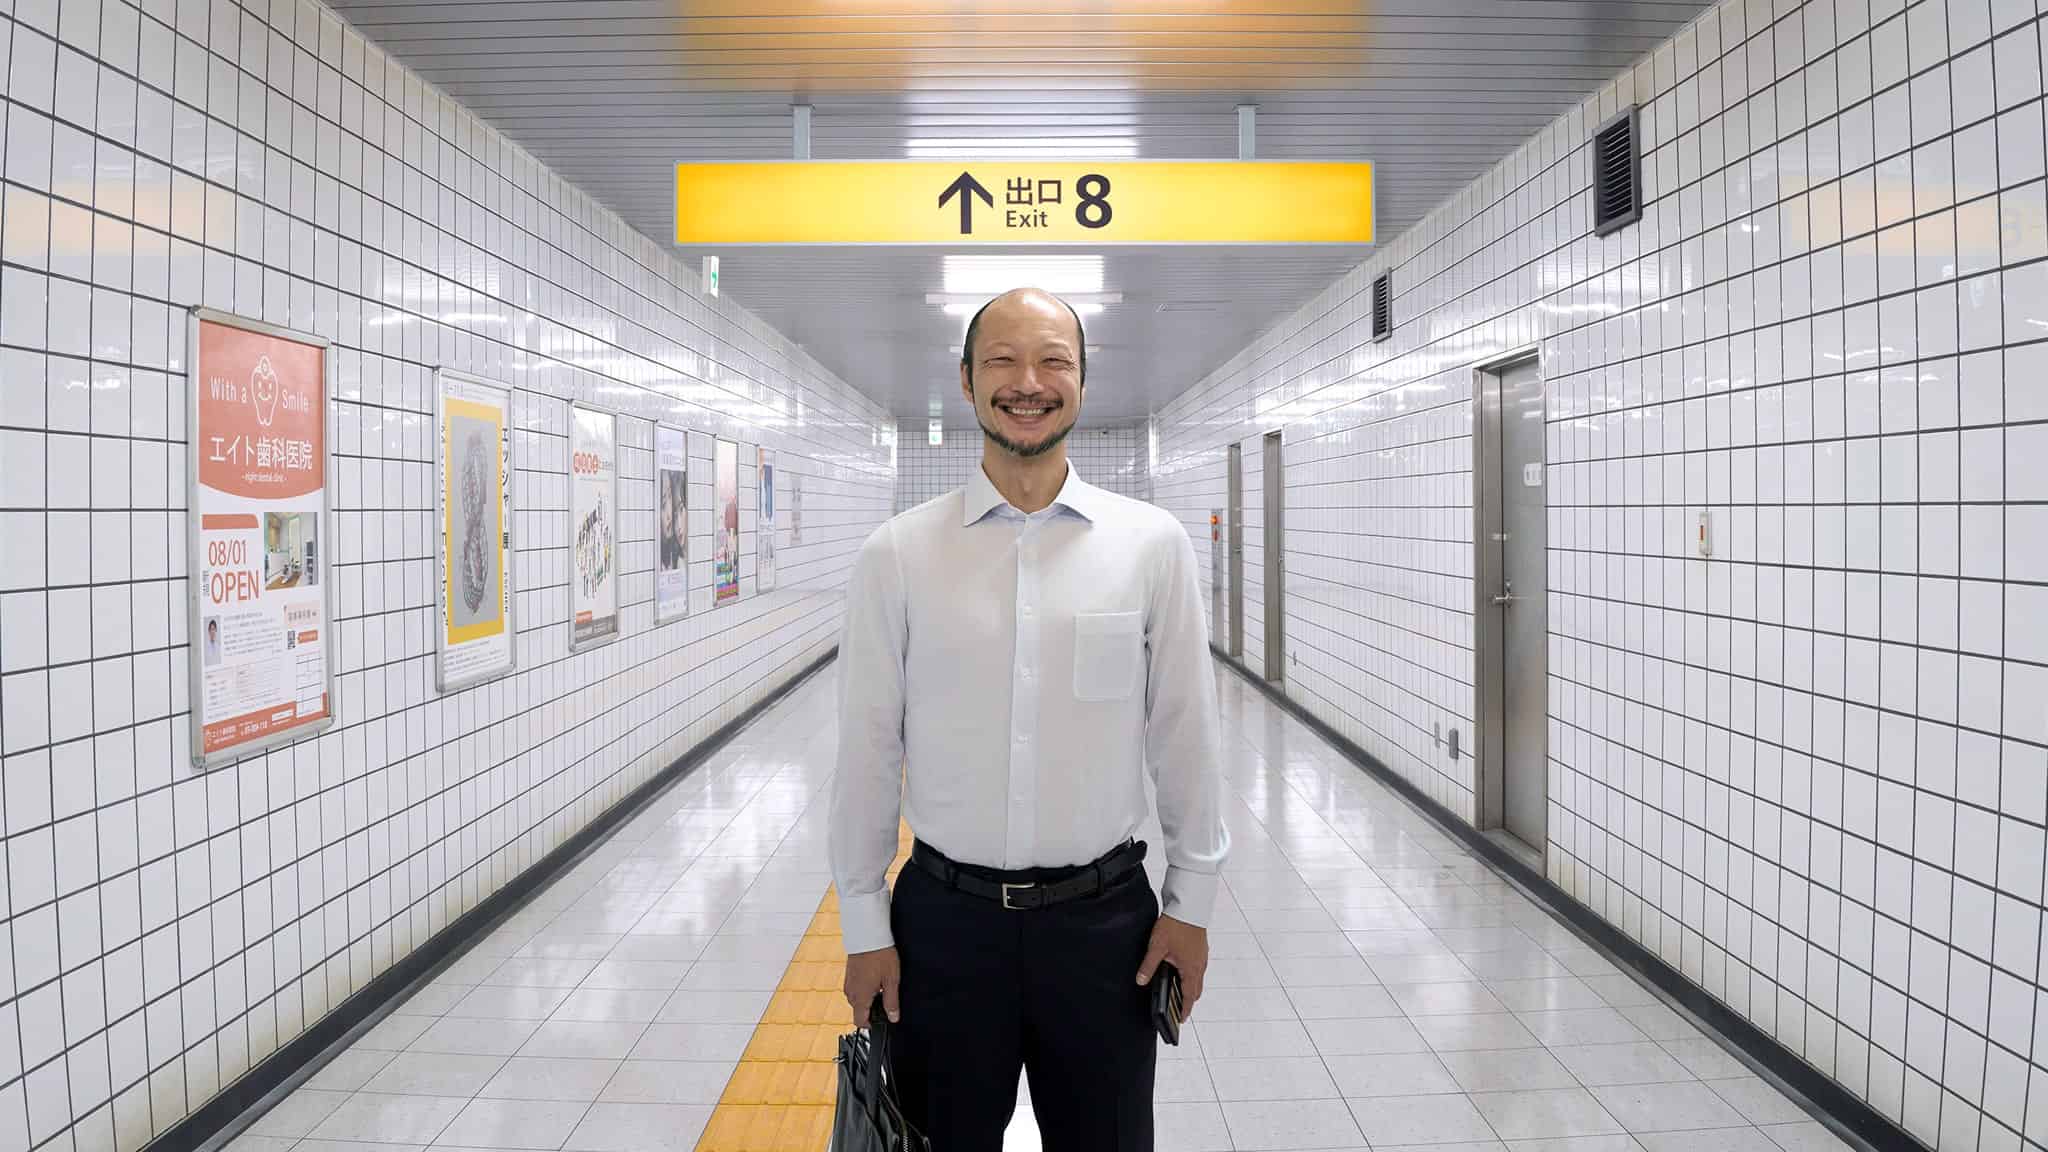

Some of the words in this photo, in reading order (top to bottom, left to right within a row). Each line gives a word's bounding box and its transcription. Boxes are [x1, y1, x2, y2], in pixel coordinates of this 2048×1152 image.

[1006, 177, 1061, 206] 出口
[1075, 174, 1112, 229] 8
[1006, 209, 1048, 228] Exit
[210, 376, 237, 401] With
[241, 385, 248, 404] a
[282, 388, 310, 414] Smile
[209, 435, 313, 470] エイト歯科医院
[208, 540, 247, 567] 08/01
[211, 570, 259, 604] OPEN
